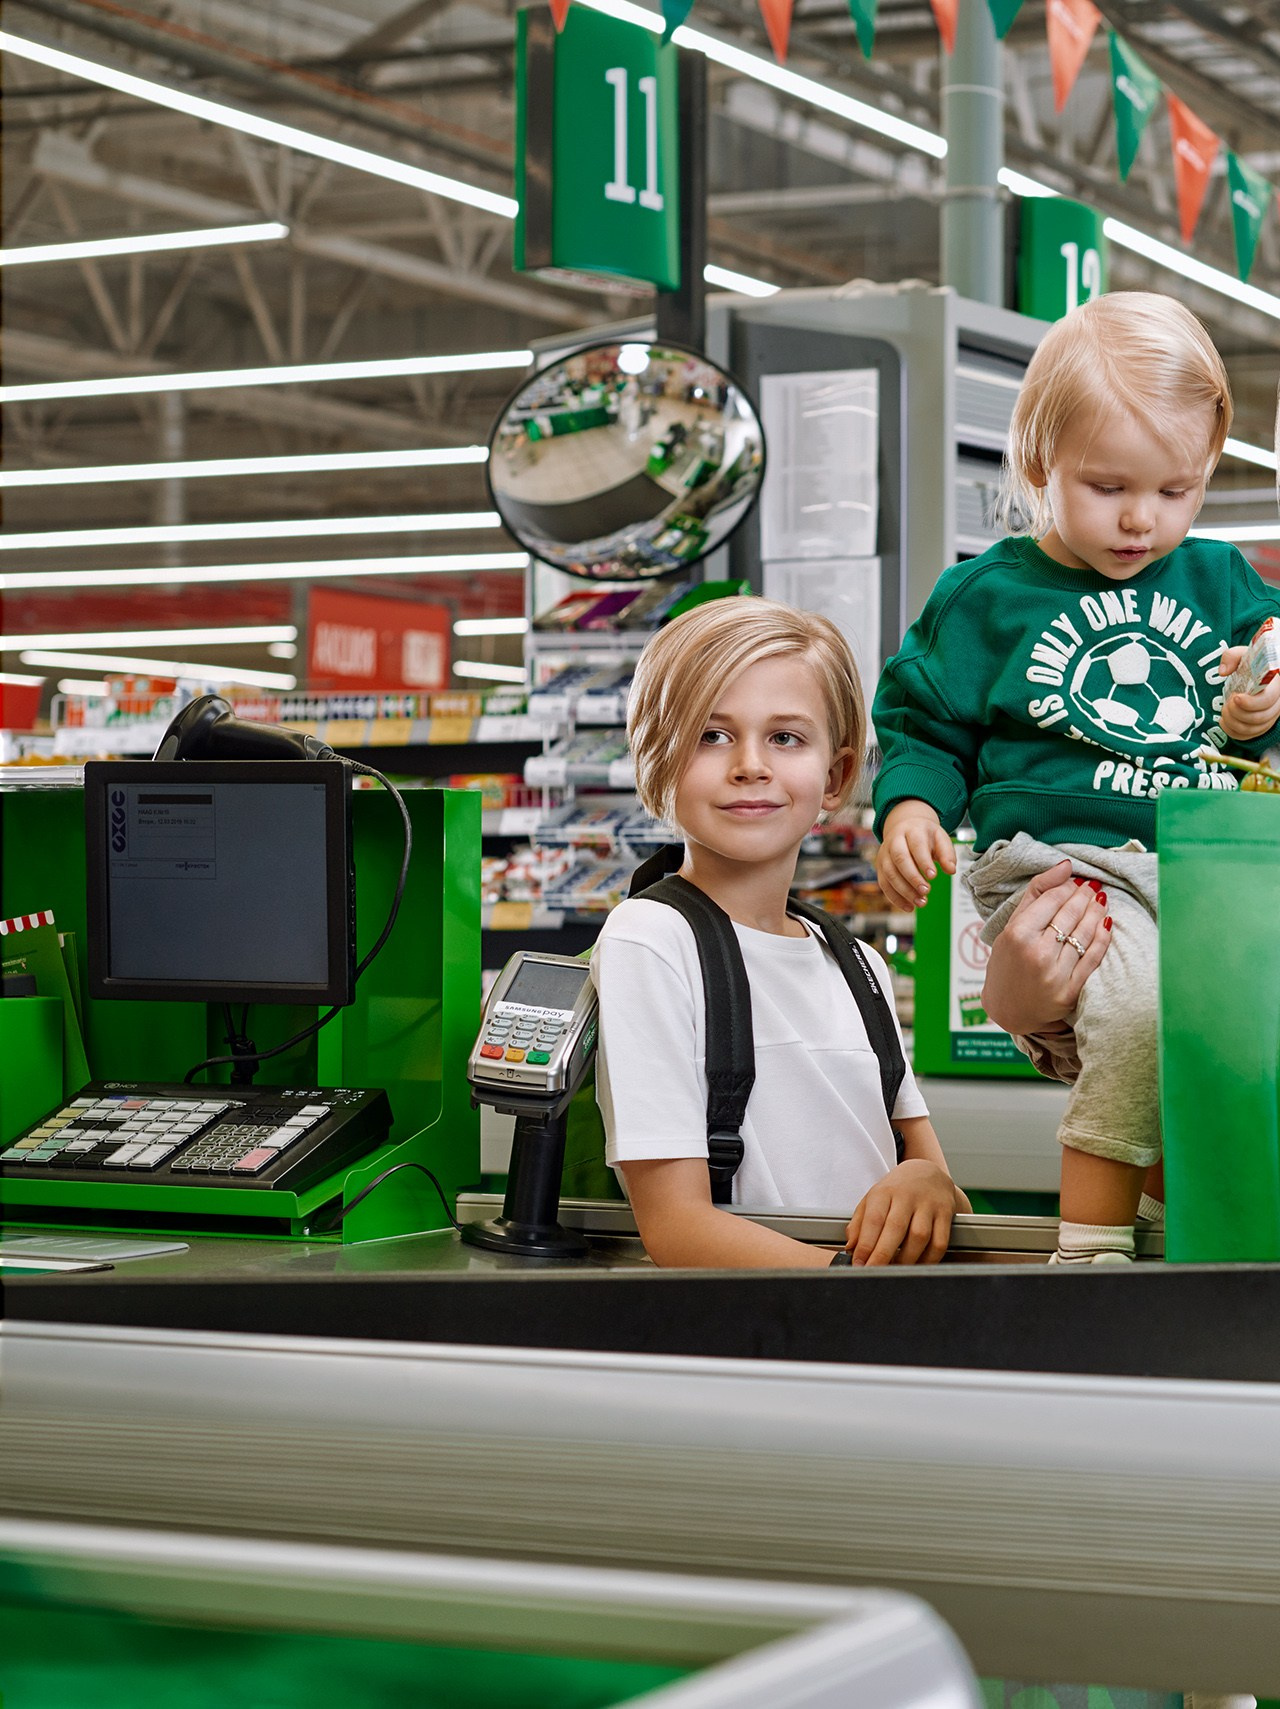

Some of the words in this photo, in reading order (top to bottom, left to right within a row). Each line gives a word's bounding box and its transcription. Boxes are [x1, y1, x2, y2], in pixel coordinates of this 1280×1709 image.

[605, 67, 664, 212] 11
[1079, 589, 1141, 632] ONE
[1148, 591, 1212, 650] WAY
[1026, 612, 1083, 687] ONLY
[1028, 694, 1068, 728] IS
[505, 1005, 542, 1014] SAMSUNG
[542, 1009, 565, 1018] pay
